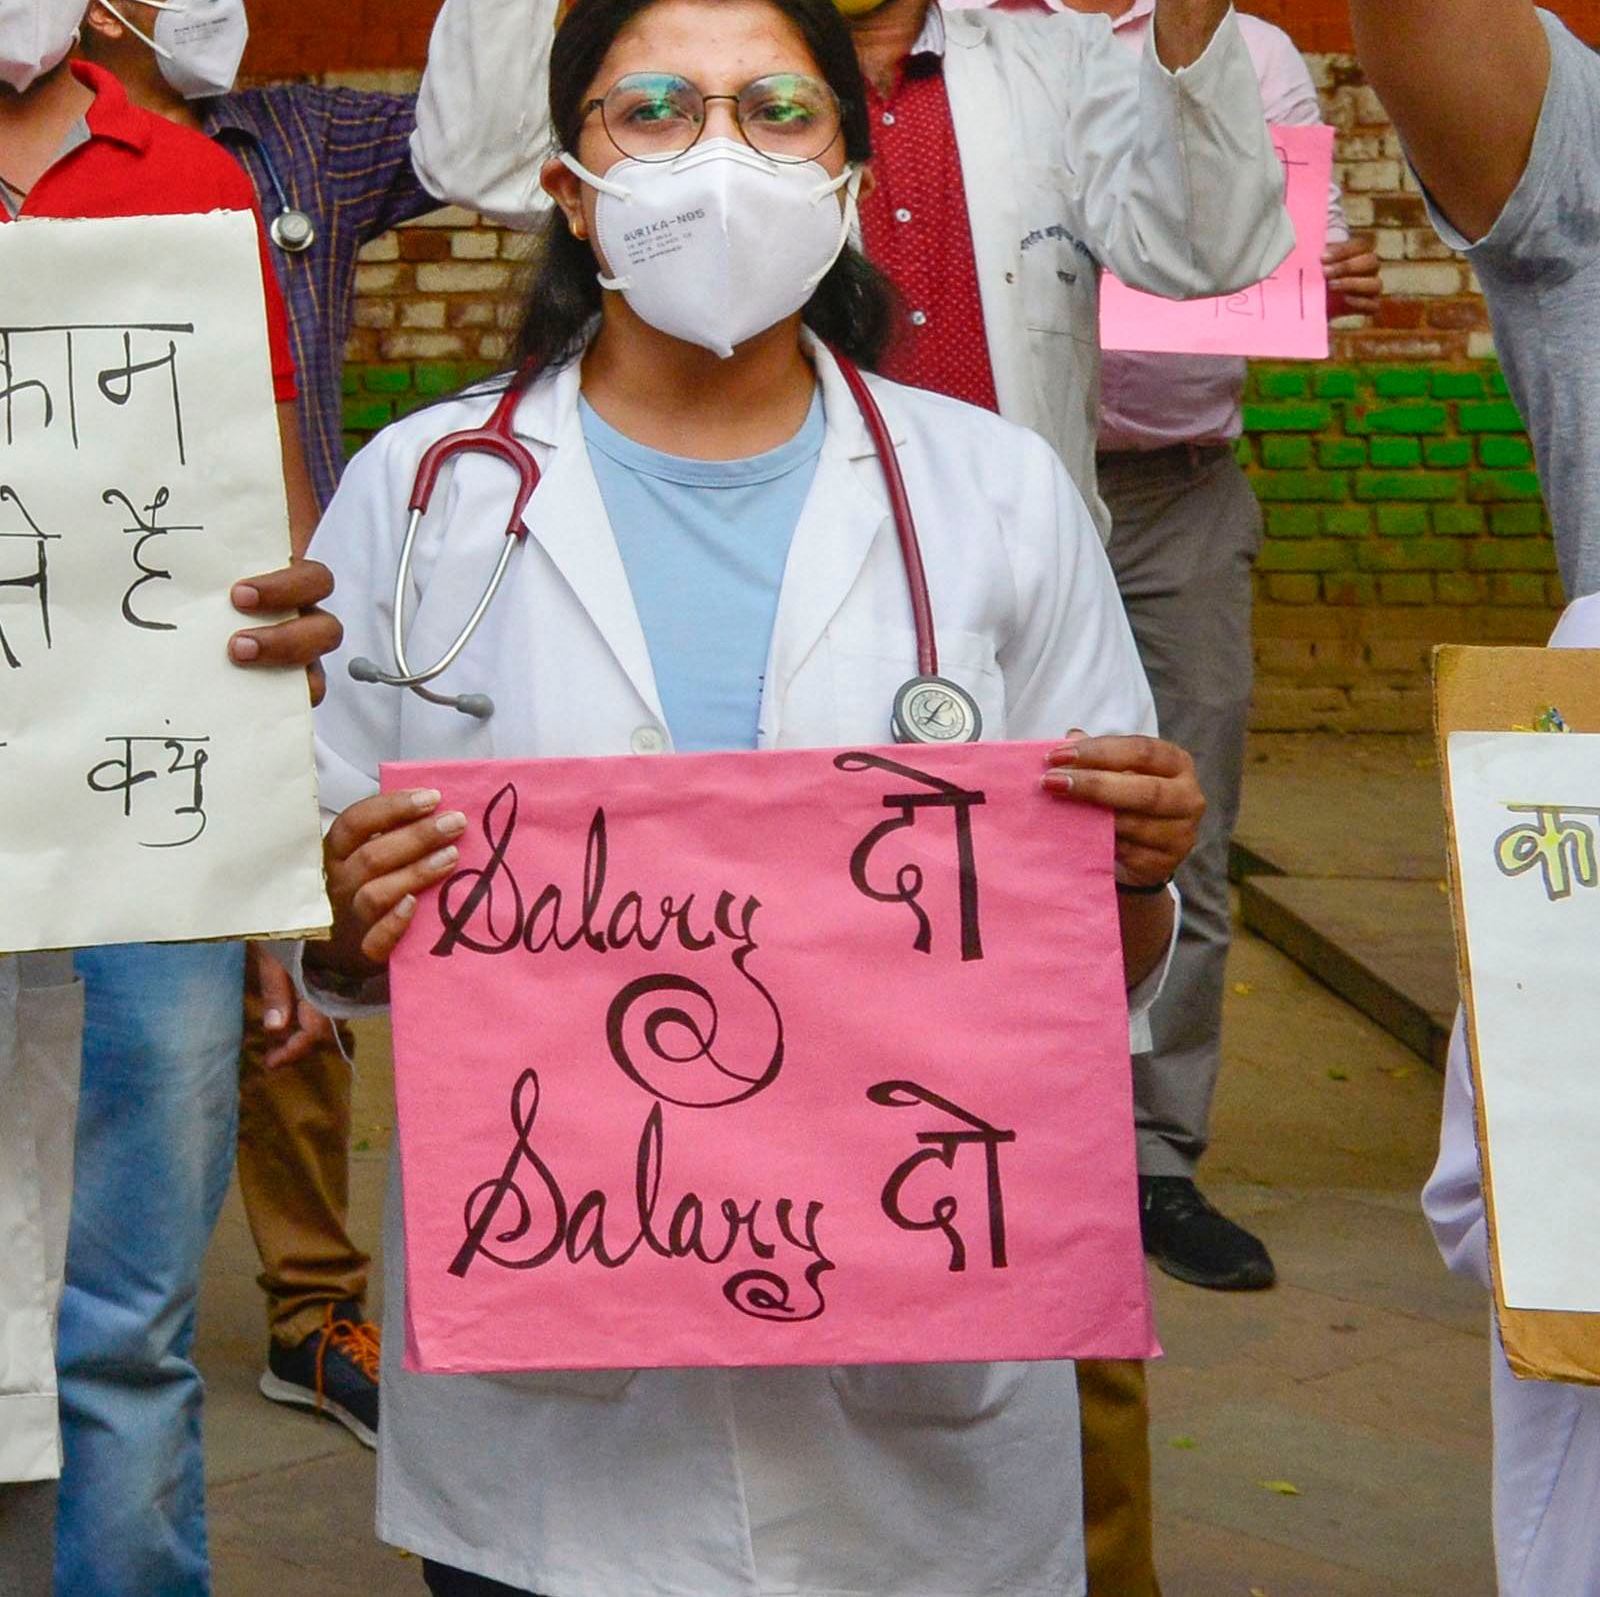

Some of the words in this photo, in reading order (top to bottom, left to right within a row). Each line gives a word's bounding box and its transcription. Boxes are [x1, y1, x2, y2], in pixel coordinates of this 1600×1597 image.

[428, 782, 787, 1110] Salary
[832, 750, 987, 962] दो
[447, 1067, 837, 1324] Salary
[865, 1079, 1017, 1273] दो
